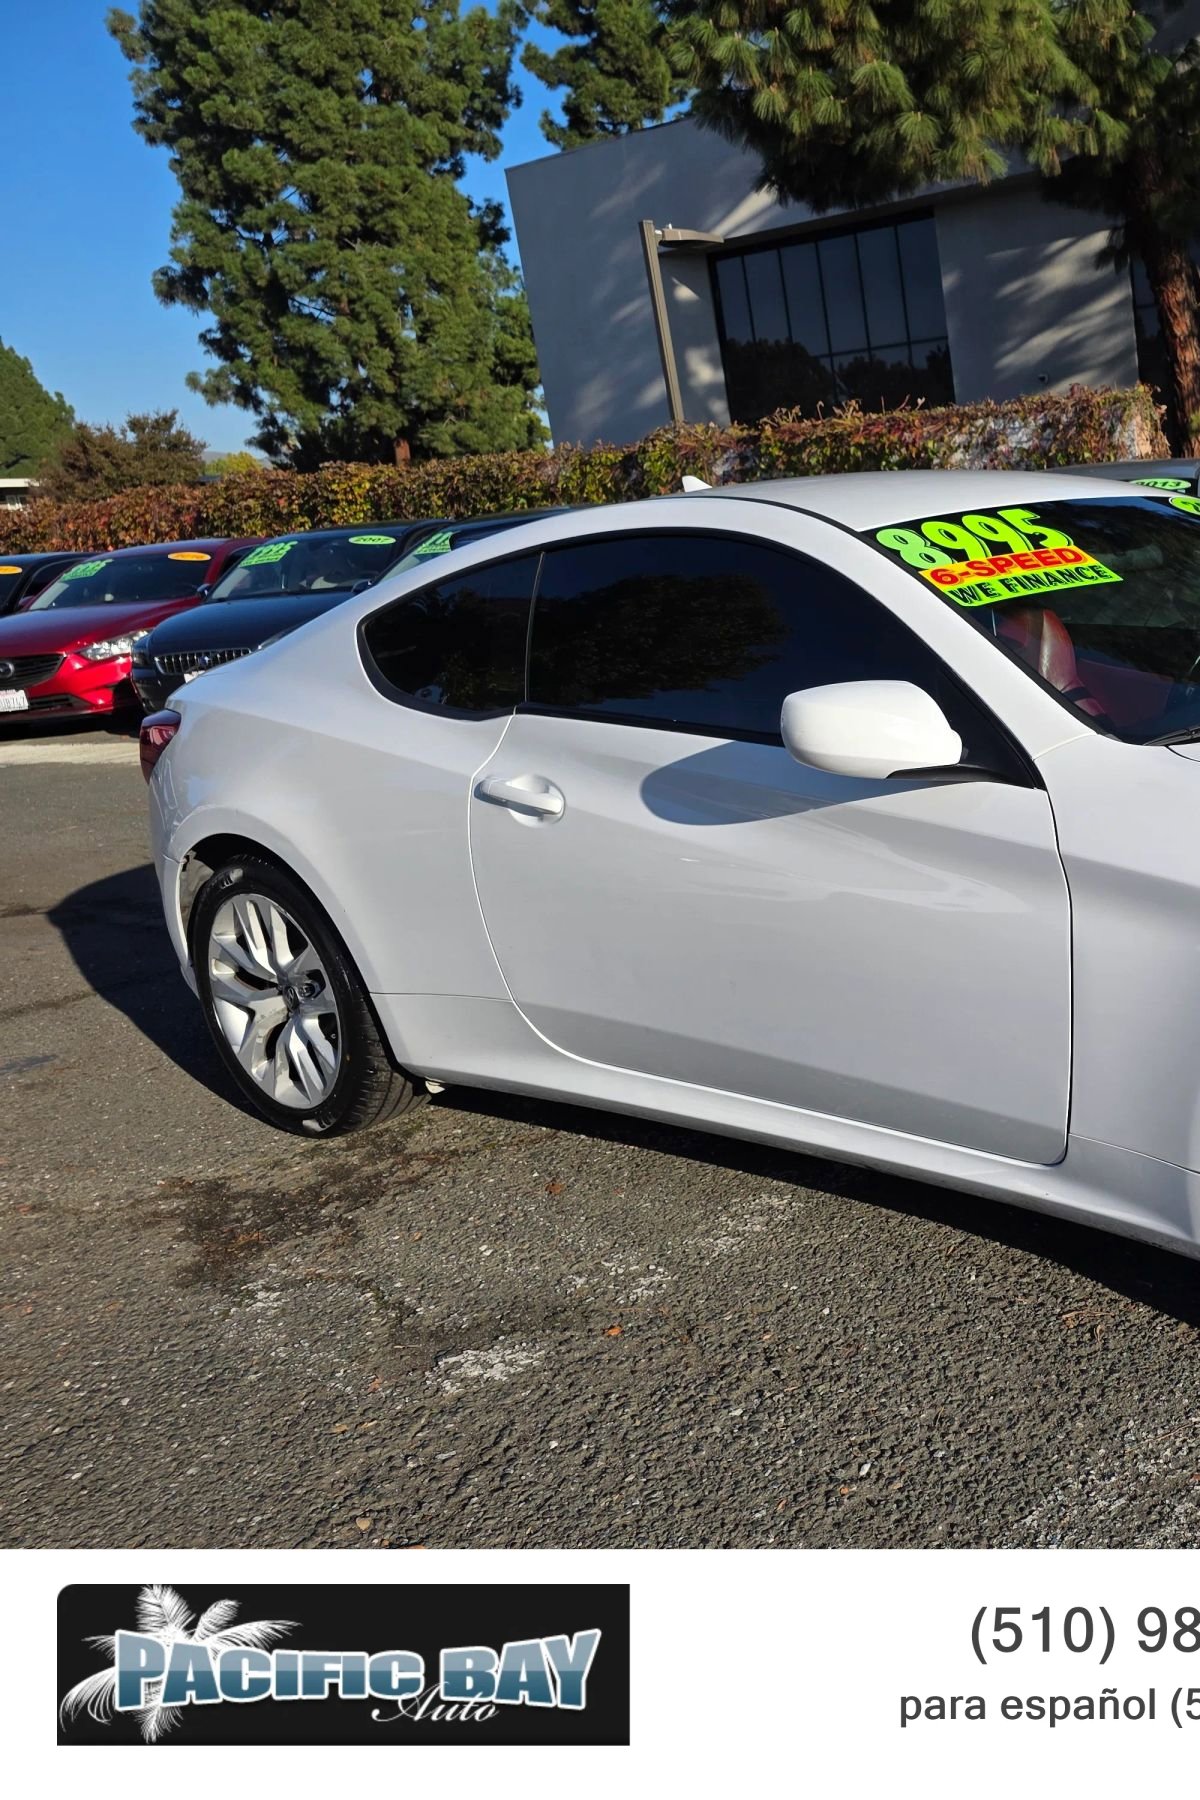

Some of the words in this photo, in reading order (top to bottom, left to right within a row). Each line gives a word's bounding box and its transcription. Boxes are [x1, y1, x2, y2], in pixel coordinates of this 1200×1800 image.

[876, 508, 1074, 569] 8995
[930, 547, 1087, 587] 6-SPEED
[947, 580, 1000, 605] WE
[1000, 564, 1114, 594] FINANCE
